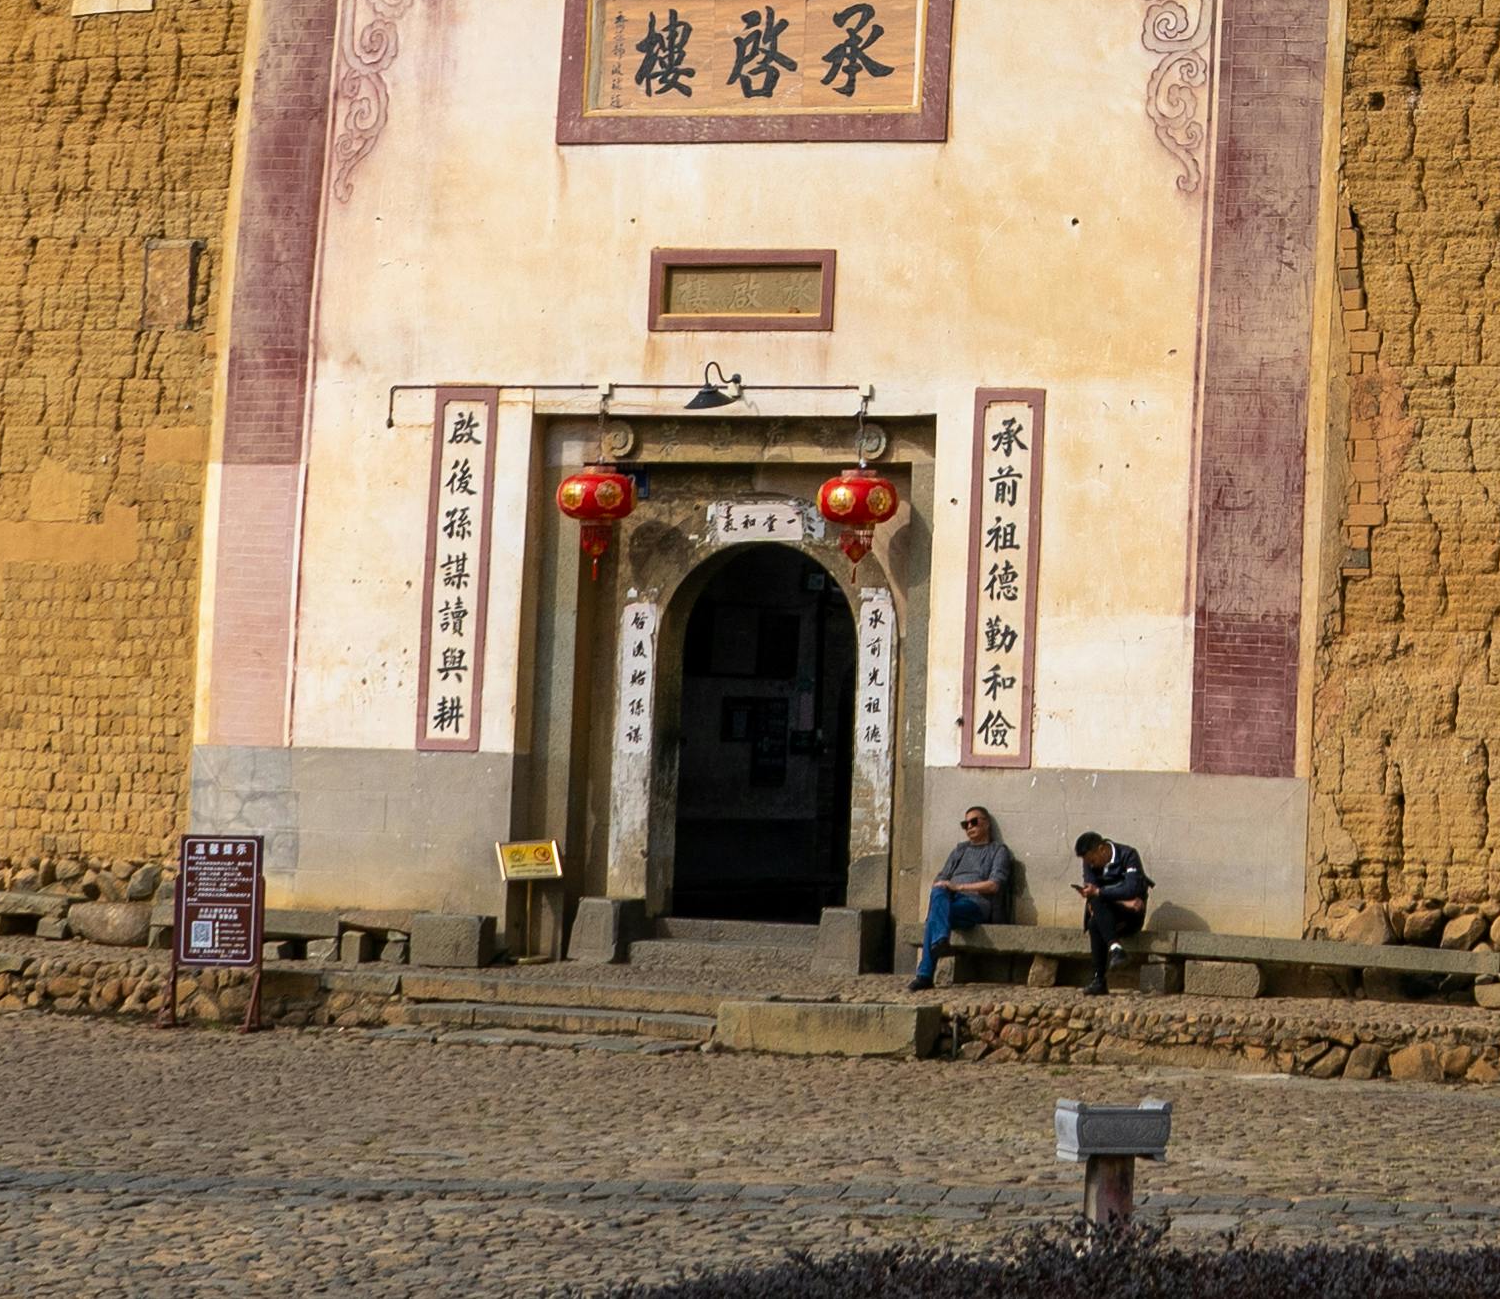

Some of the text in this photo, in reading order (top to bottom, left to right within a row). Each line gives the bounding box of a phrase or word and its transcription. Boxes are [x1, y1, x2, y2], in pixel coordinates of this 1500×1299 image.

[977, 417, 1029, 748] 承前祖德勤和儉
